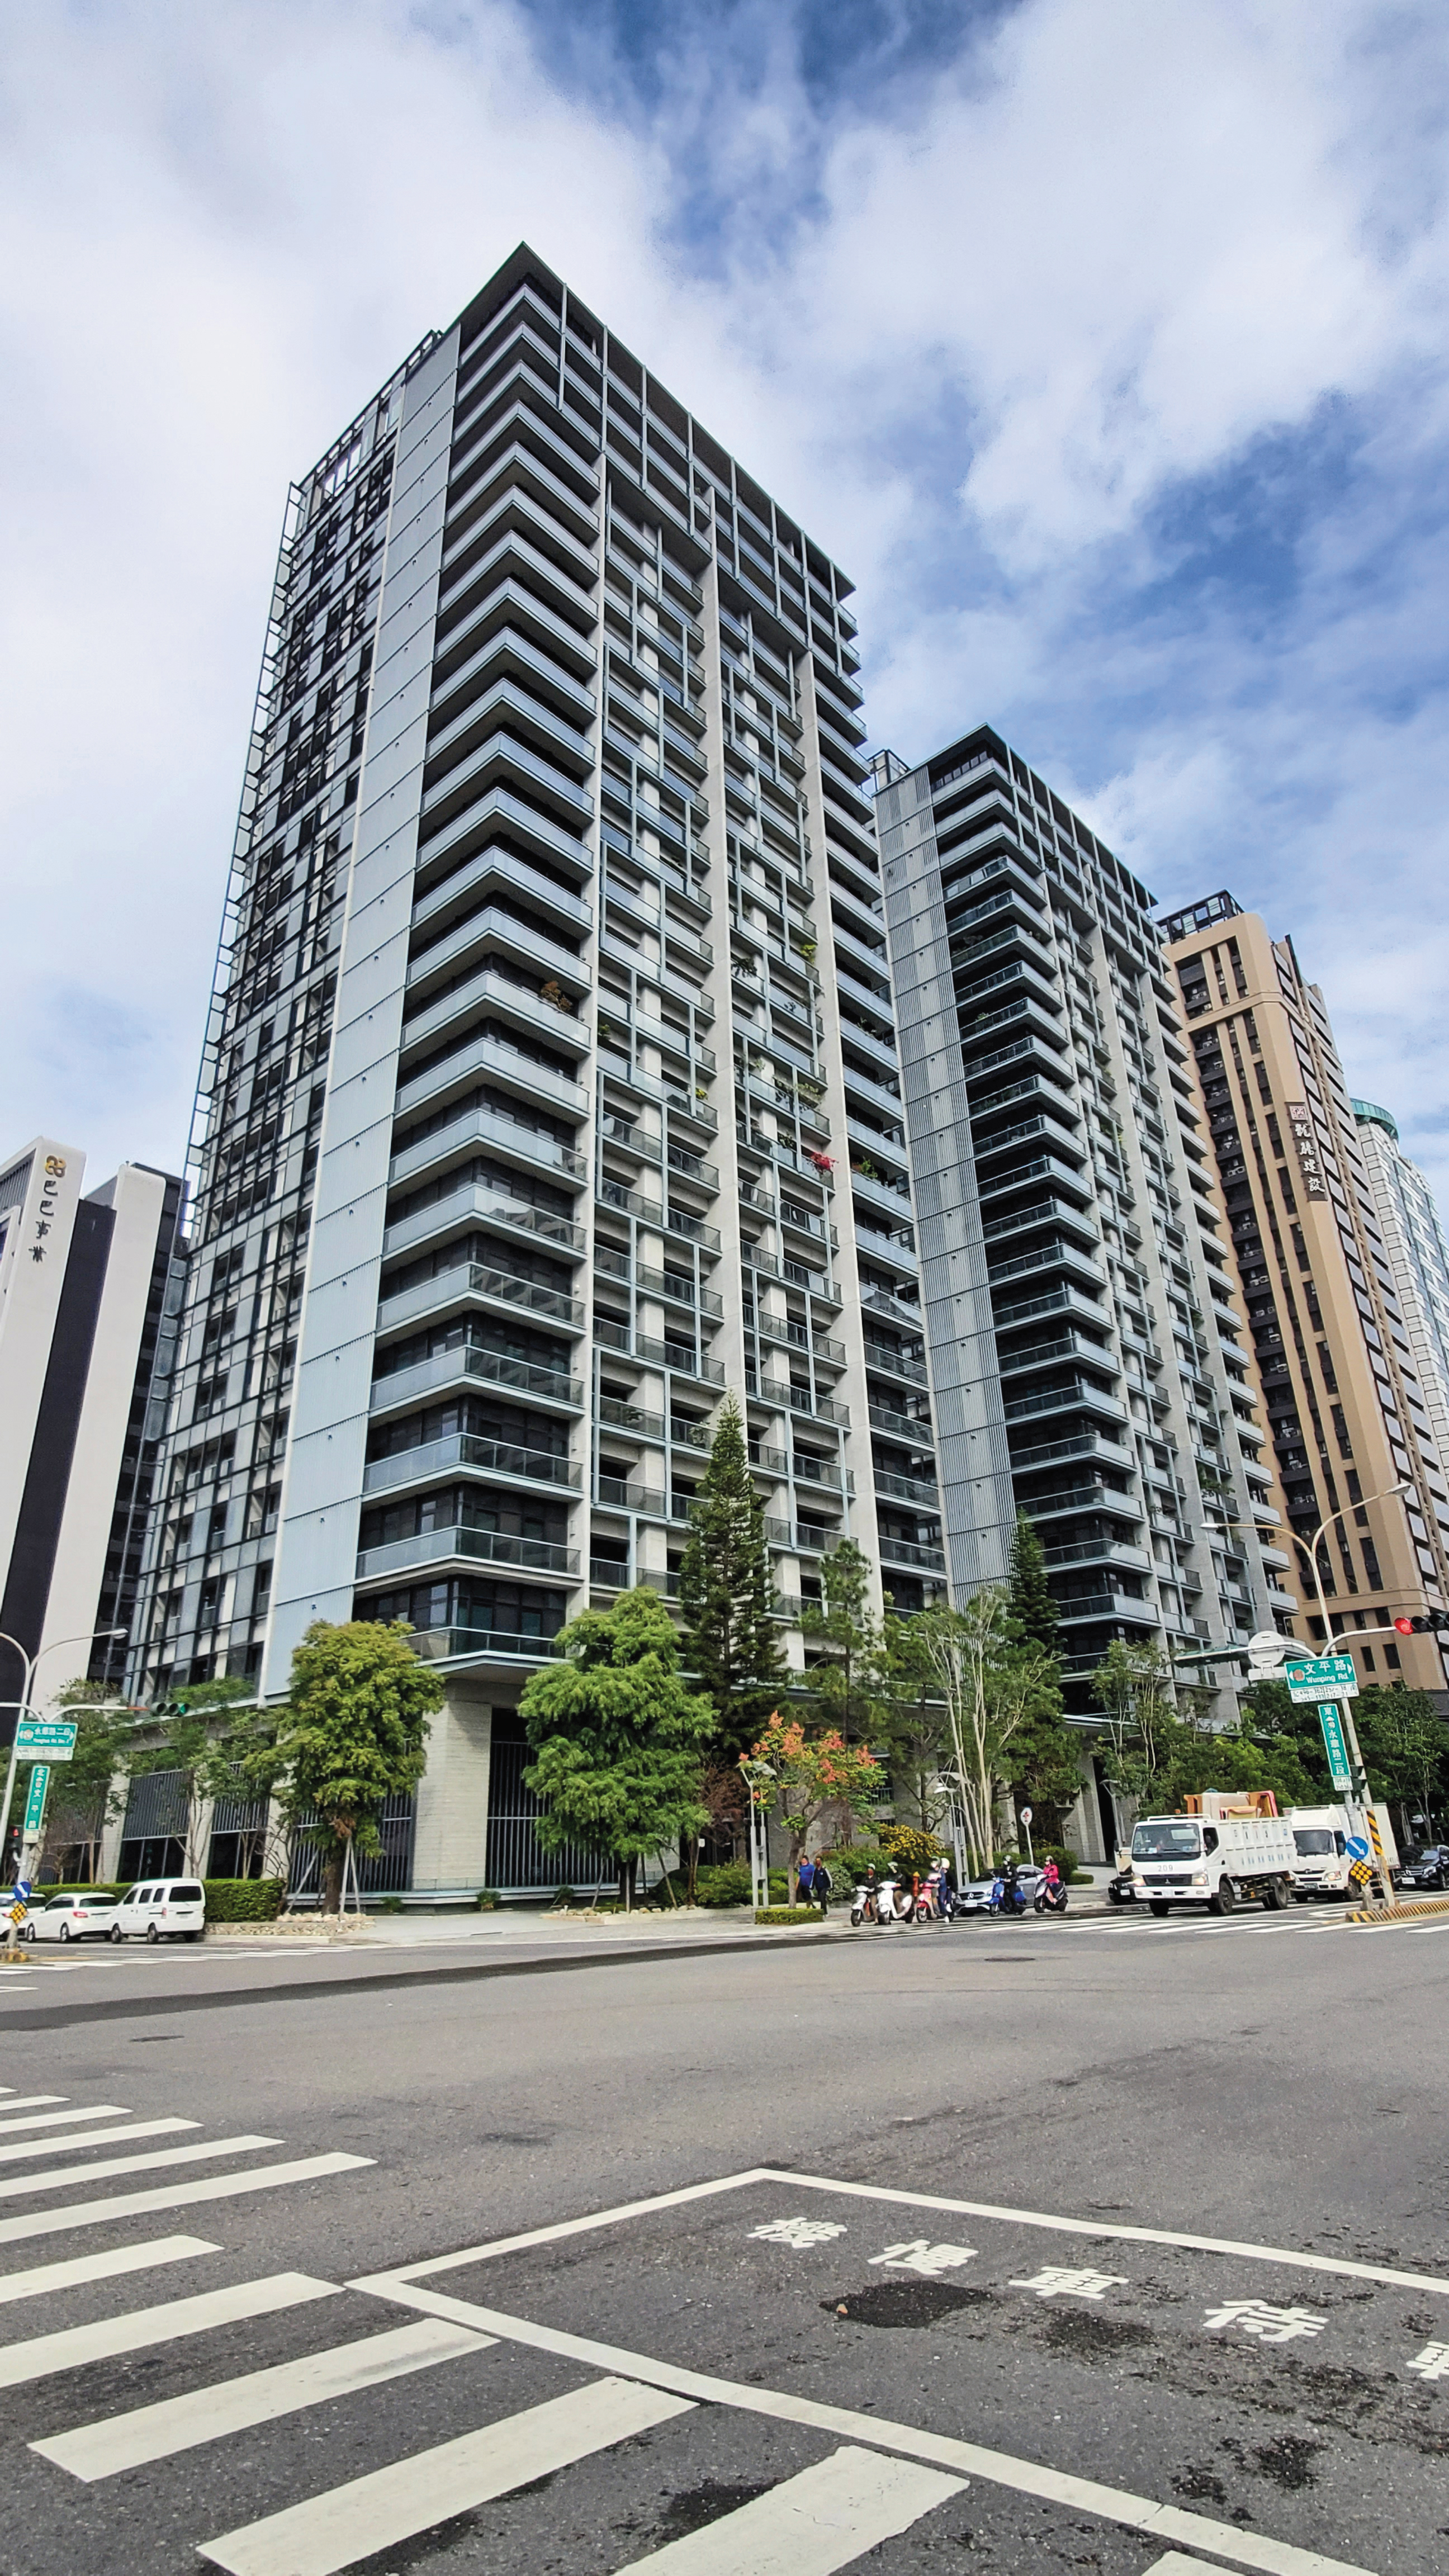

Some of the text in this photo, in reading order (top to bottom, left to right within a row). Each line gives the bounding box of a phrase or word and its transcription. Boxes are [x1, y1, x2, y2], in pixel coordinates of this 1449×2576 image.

[1304, 1659, 1346, 1675] 文平路
[1306, 1675, 1336, 1683] Wunping
[1328, 1729, 1345, 1774] 永華路二段
